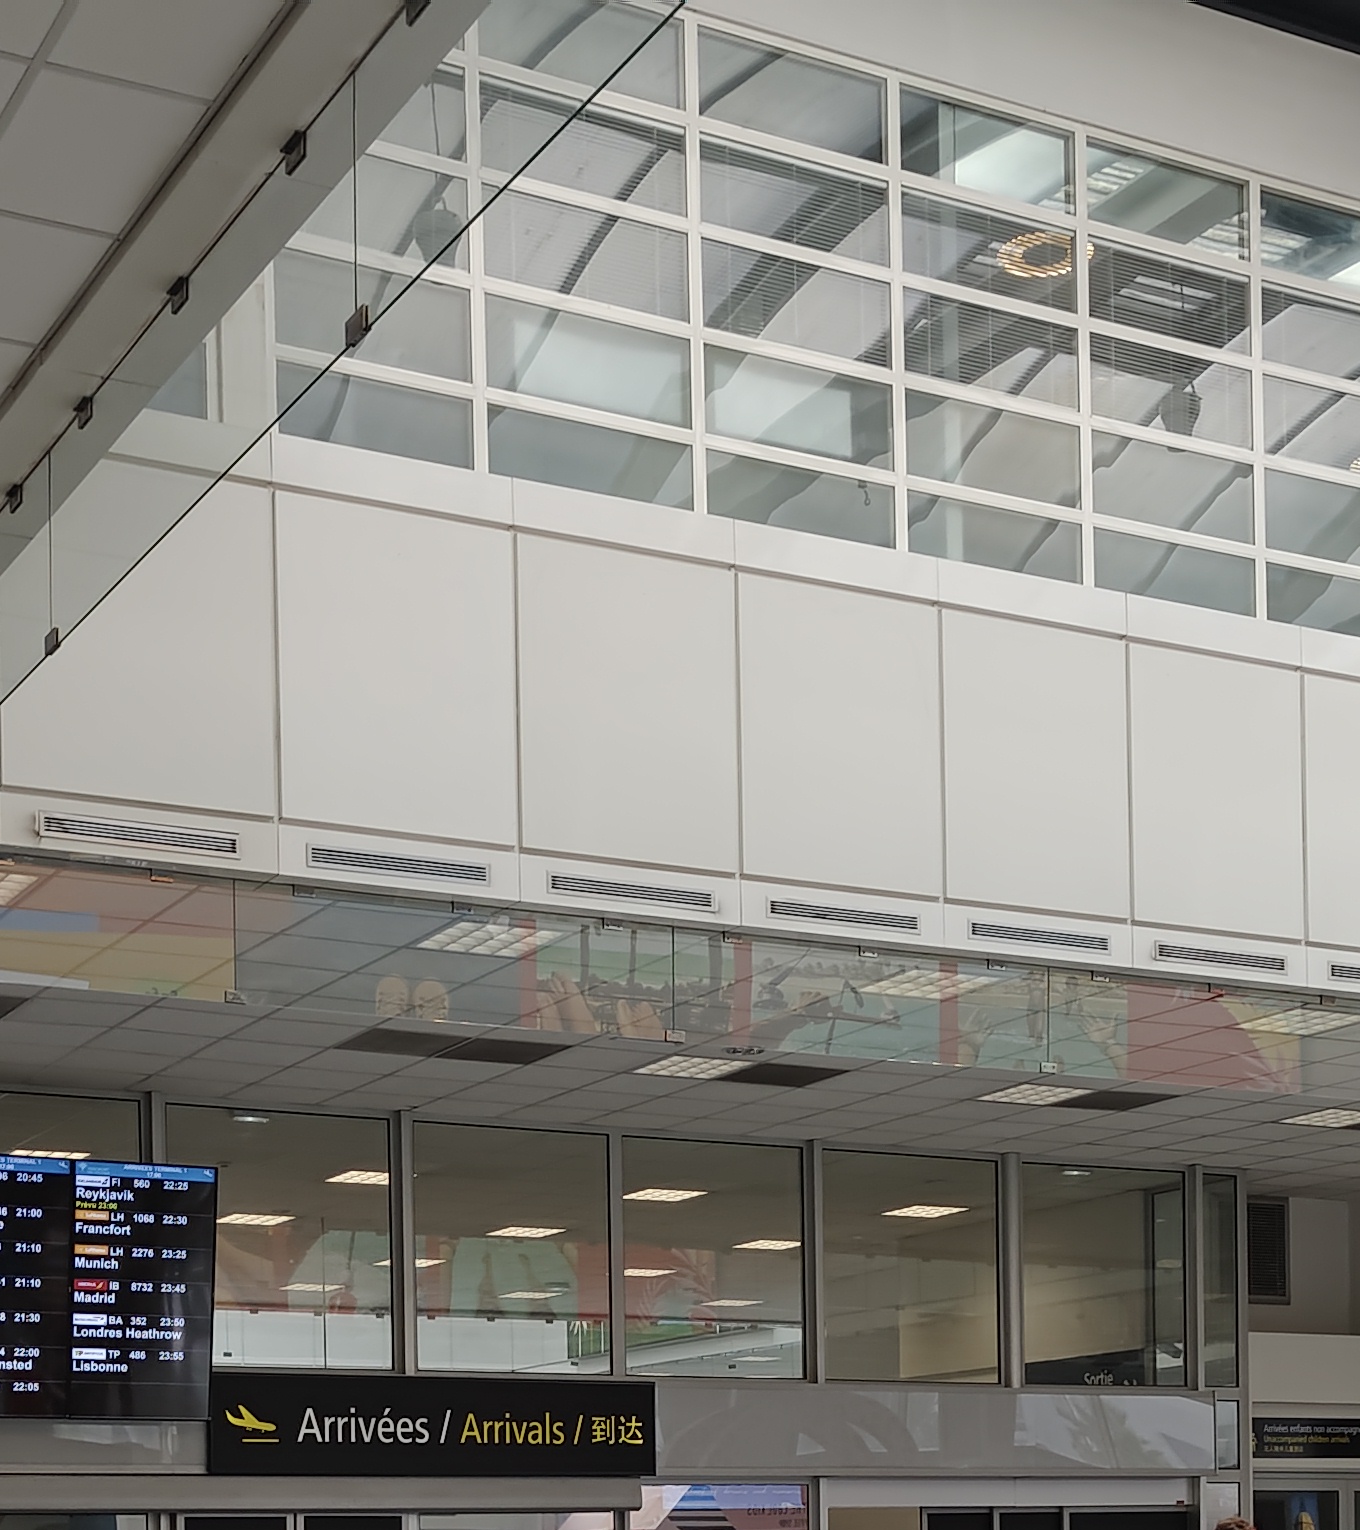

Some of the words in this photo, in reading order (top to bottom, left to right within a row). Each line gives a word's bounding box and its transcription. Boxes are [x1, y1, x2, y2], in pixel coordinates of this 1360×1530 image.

[17, 1173, 43, 1182] 20:45
[112, 1178, 120, 1186] FI
[76, 1188, 134, 1202] Reykjavik
[16, 1208, 42, 1217] 21:00
[111, 1212, 124, 1222] LH
[163, 1215, 187, 1225] 22:30
[76, 1222, 131, 1235] Francfort
[15, 1243, 41, 1253] 21:10
[110, 1247, 123, 1256] LH
[162, 1250, 186, 1259] 23:25
[75, 1257, 118, 1269] Munich
[15, 1278, 40, 1287] 21:10
[110, 1282, 119, 1290] IB
[161, 1284, 186, 1293] 23:45
[74, 1292, 115, 1303] Madrid
[14, 1313, 40, 1322] 21:30
[109, 1316, 123, 1325] BA
[73, 1326, 122, 1337] Londres
[126, 1328, 182, 1339] Heathrow
[14, 1348, 40, 1357] 22:00
[108, 1350, 120, 1358] TP
[73, 1360, 128, 1372] Lisbonne
[13, 1383, 39, 1391] 22:05
[297, 1407, 429, 1443] Arrivées
[460, 1412, 564, 1445] Arrivals
[591, 1416, 644, 1445] 到达
